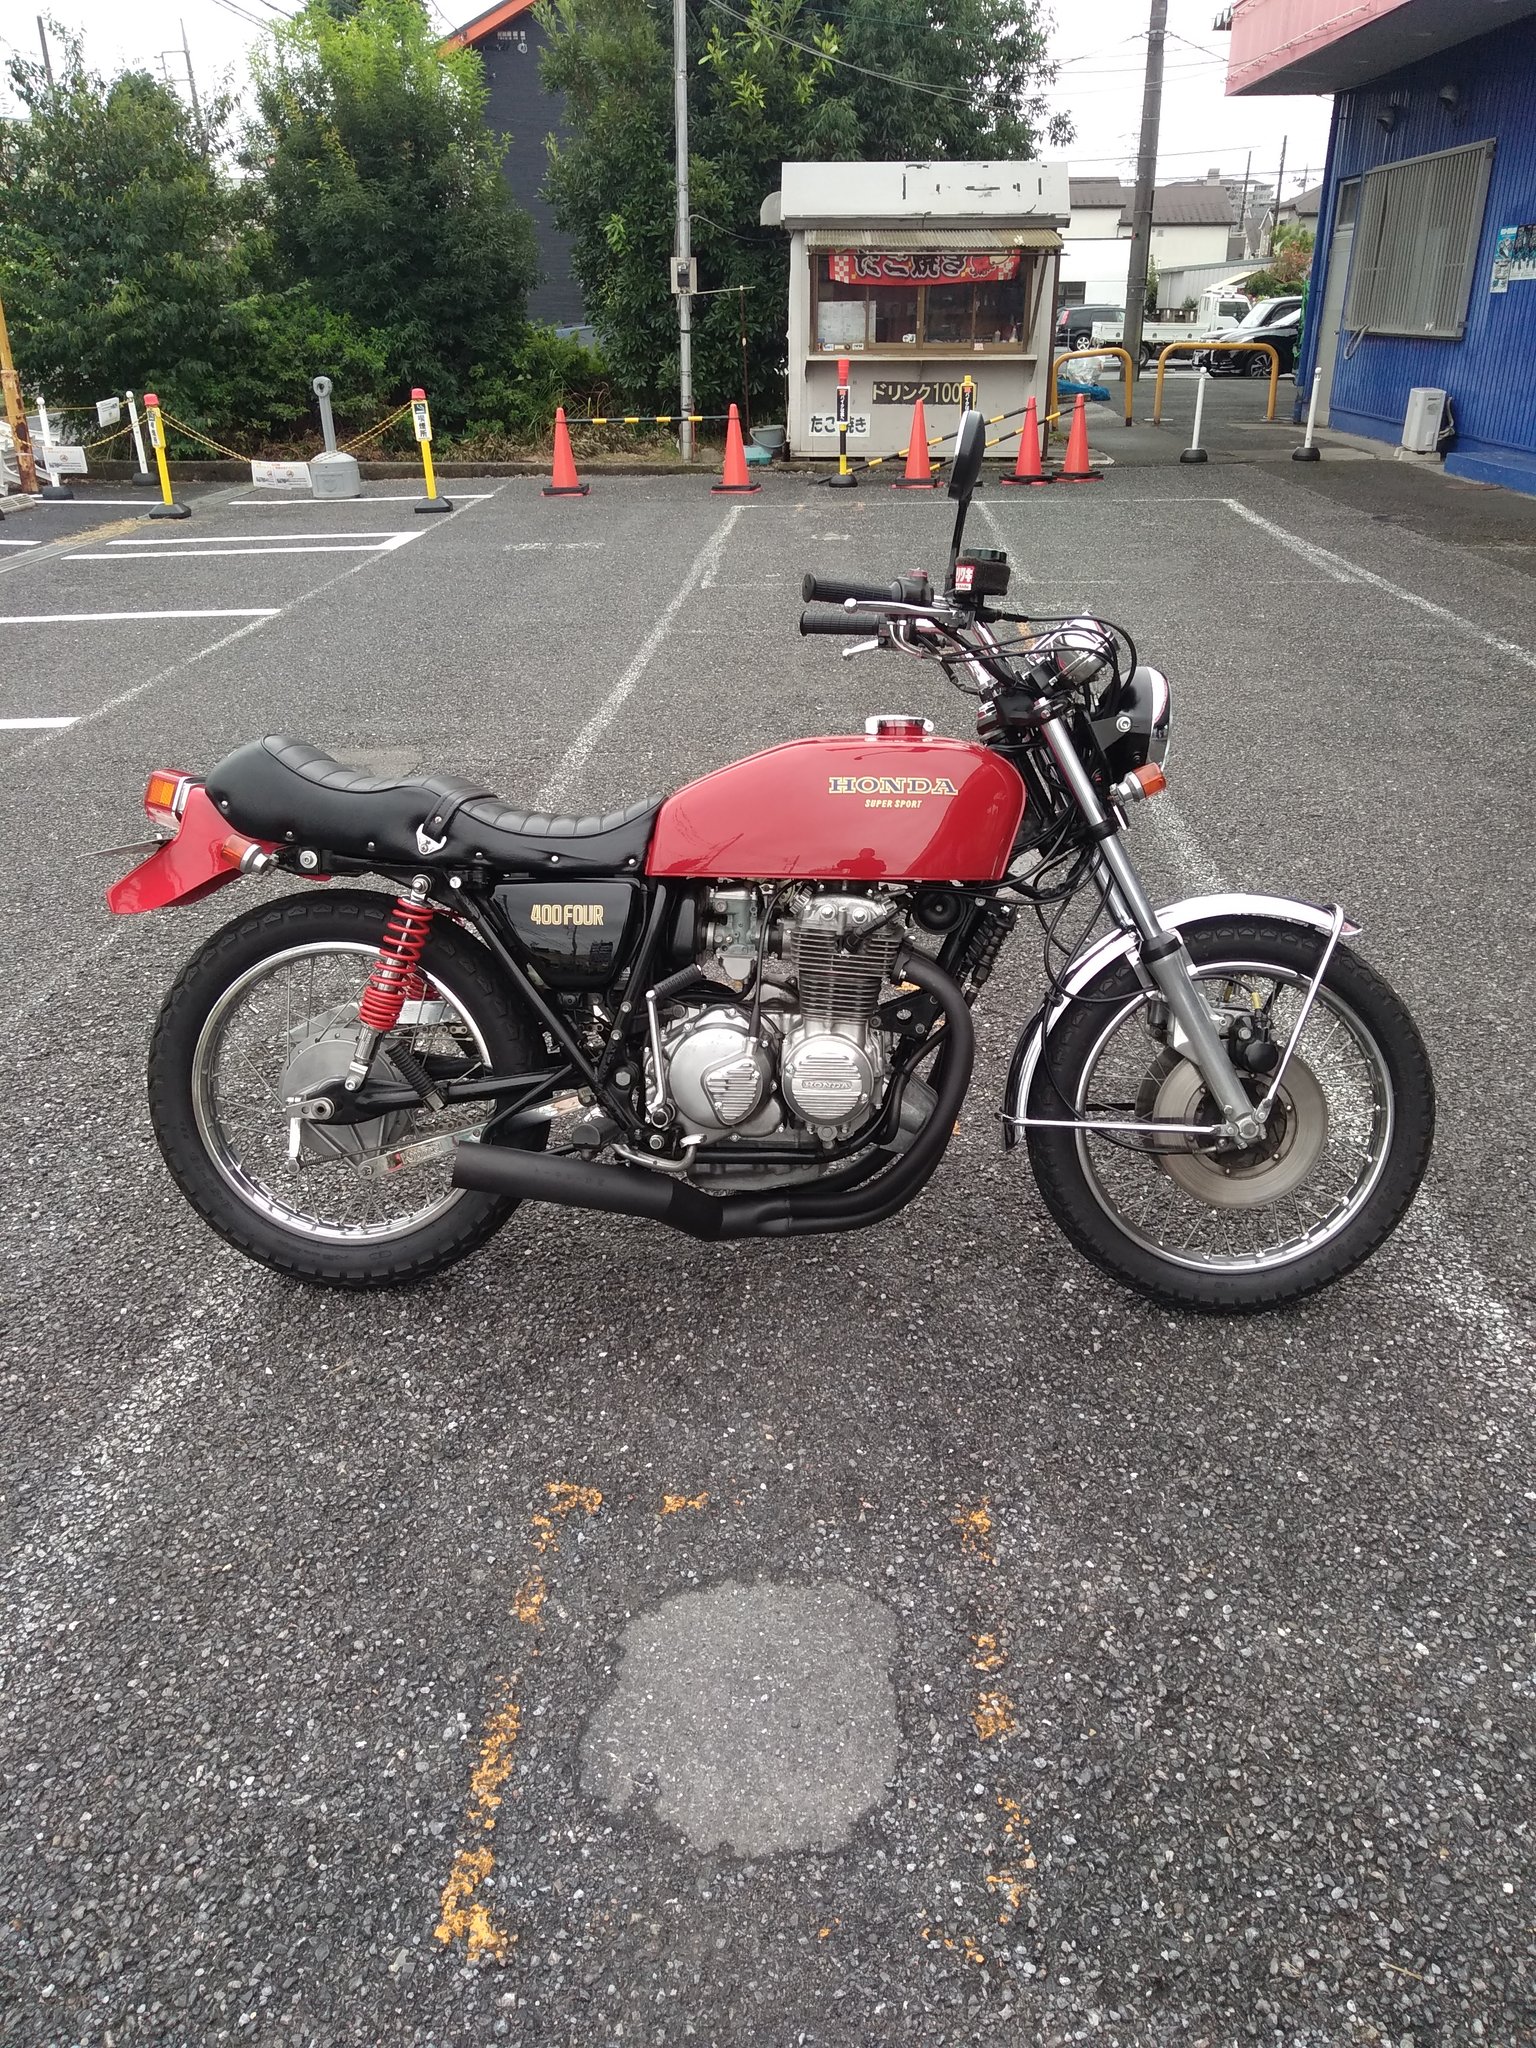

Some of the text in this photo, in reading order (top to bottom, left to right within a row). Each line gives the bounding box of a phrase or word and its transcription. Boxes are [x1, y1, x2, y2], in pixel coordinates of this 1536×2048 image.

[873, 383, 977, 402] ドリンク100
[829, 776, 958, 796] HONDA
[865, 799, 922, 809] SUPER SPORT
[530, 904, 604, 925] 400 FOUR
[803, 1080, 852, 1089] HONDA
